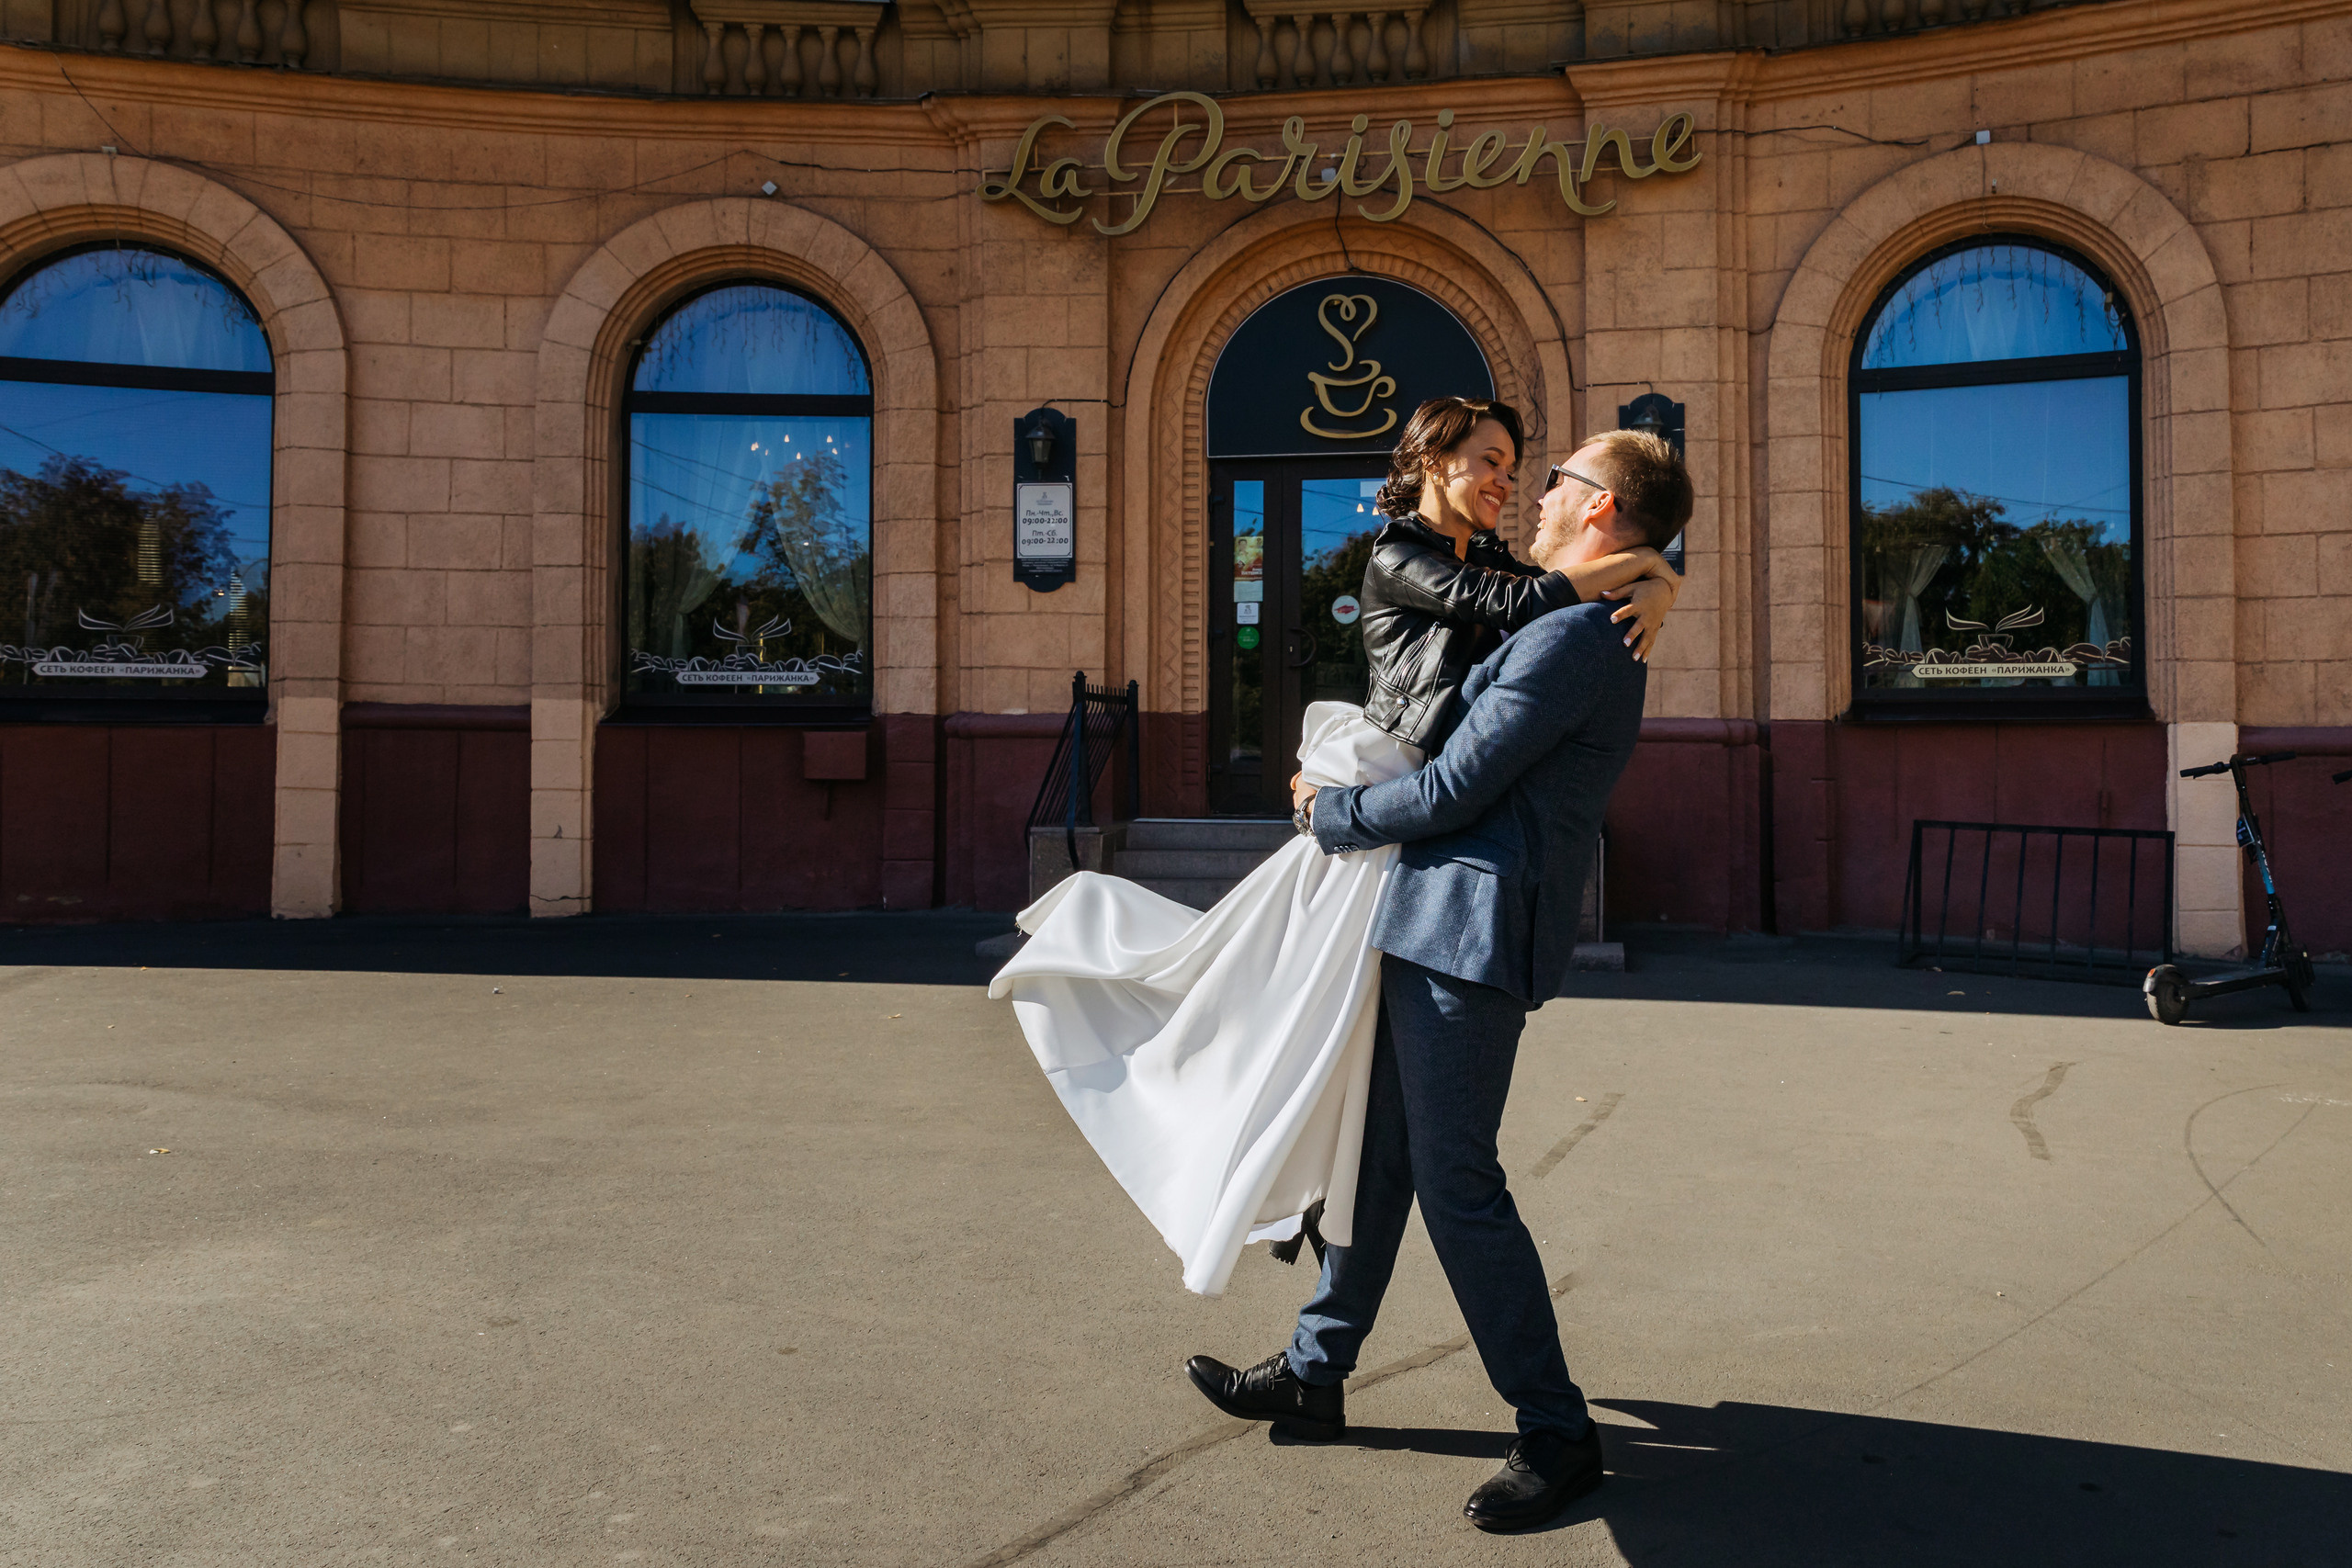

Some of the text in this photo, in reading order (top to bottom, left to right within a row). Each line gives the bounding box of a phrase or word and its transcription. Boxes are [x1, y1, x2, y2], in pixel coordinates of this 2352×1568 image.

[976, 90, 1703, 237] La Parisienne
[40, 664, 201, 676] СЕТЬ КОФЕЕН «ПАРИЖАНКА»
[1918, 665, 2071, 675] СЕТЬ КОФЕЕН «ПАРИЖАНКА»
[682, 674, 815, 683] СЕТЬ КОФЕЕН «ПАРИЖАНКА»
